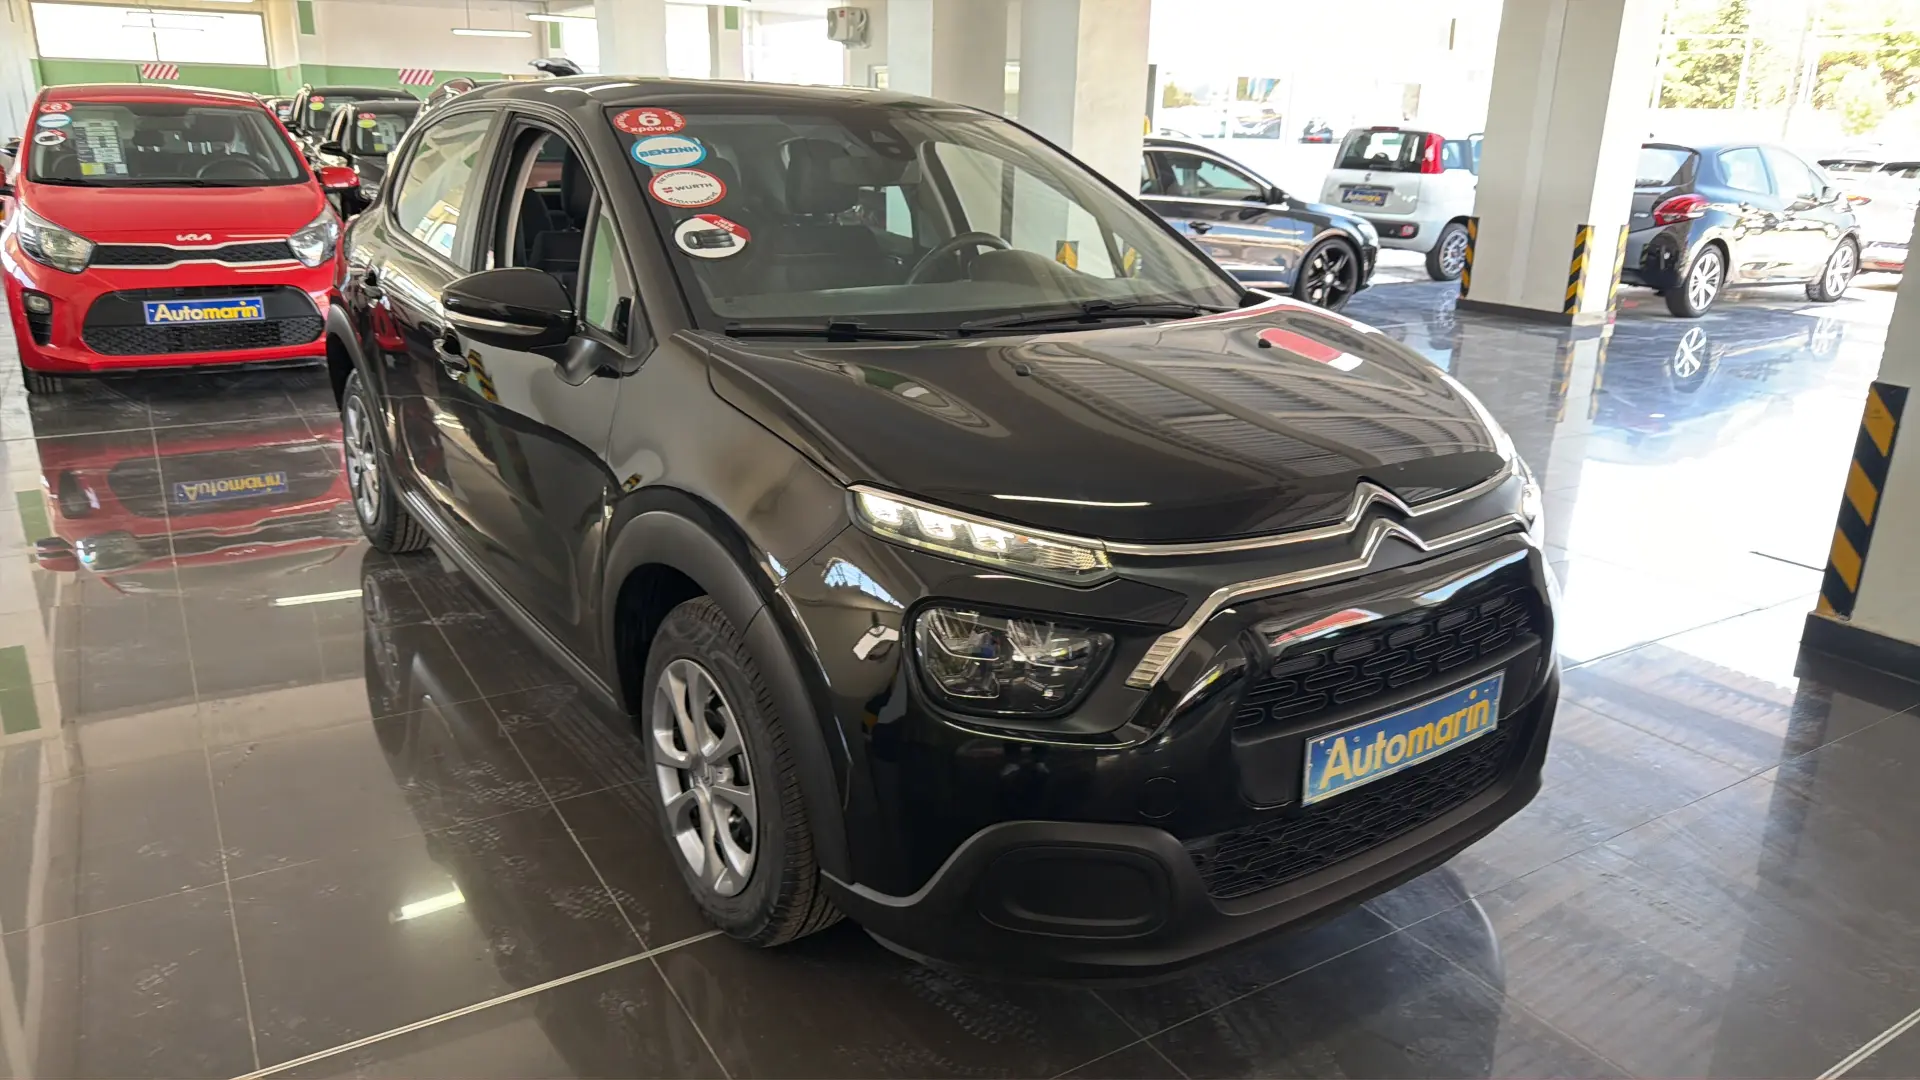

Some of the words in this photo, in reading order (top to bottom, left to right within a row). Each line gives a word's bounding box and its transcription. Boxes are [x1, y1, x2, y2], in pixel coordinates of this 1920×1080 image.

[638, 113, 661, 127] 6
[639, 146, 699, 157] ΒΕΝΖΙΝΗ
[154, 300, 259, 322] Automarin
[1319, 688, 1490, 790] Automarin
